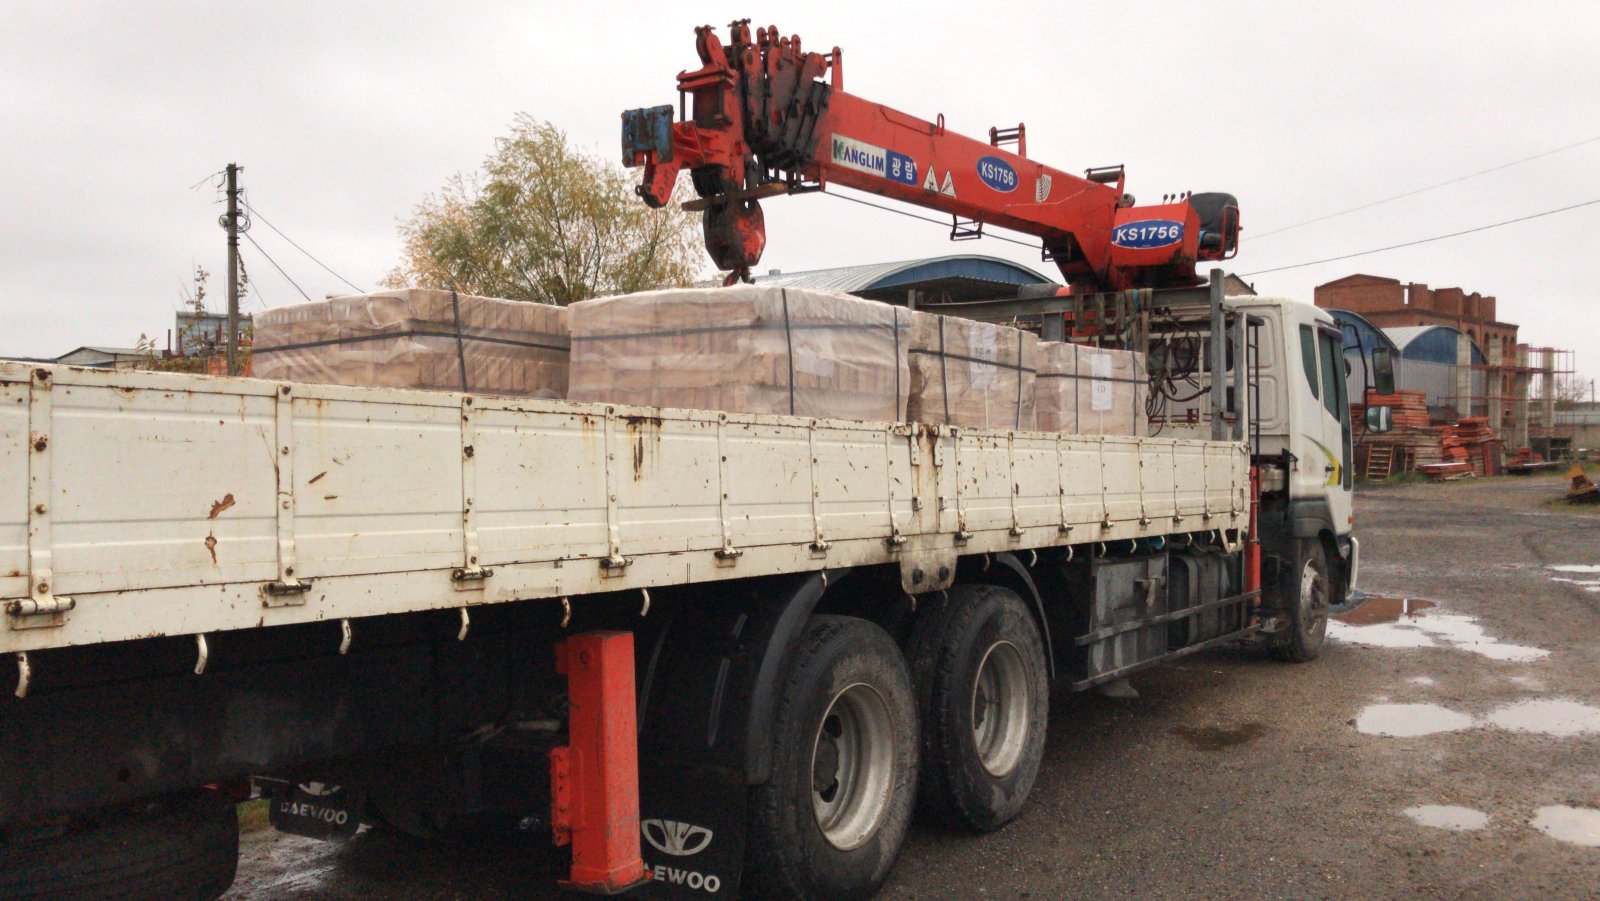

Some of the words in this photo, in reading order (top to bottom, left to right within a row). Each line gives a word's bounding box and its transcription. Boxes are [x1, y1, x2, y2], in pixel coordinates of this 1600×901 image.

[833, 141, 885, 173] KANGLIM
[981, 162, 1014, 187] KS1756
[1116, 226, 1179, 242] KS1756
[643, 863, 721, 893] EWOO
